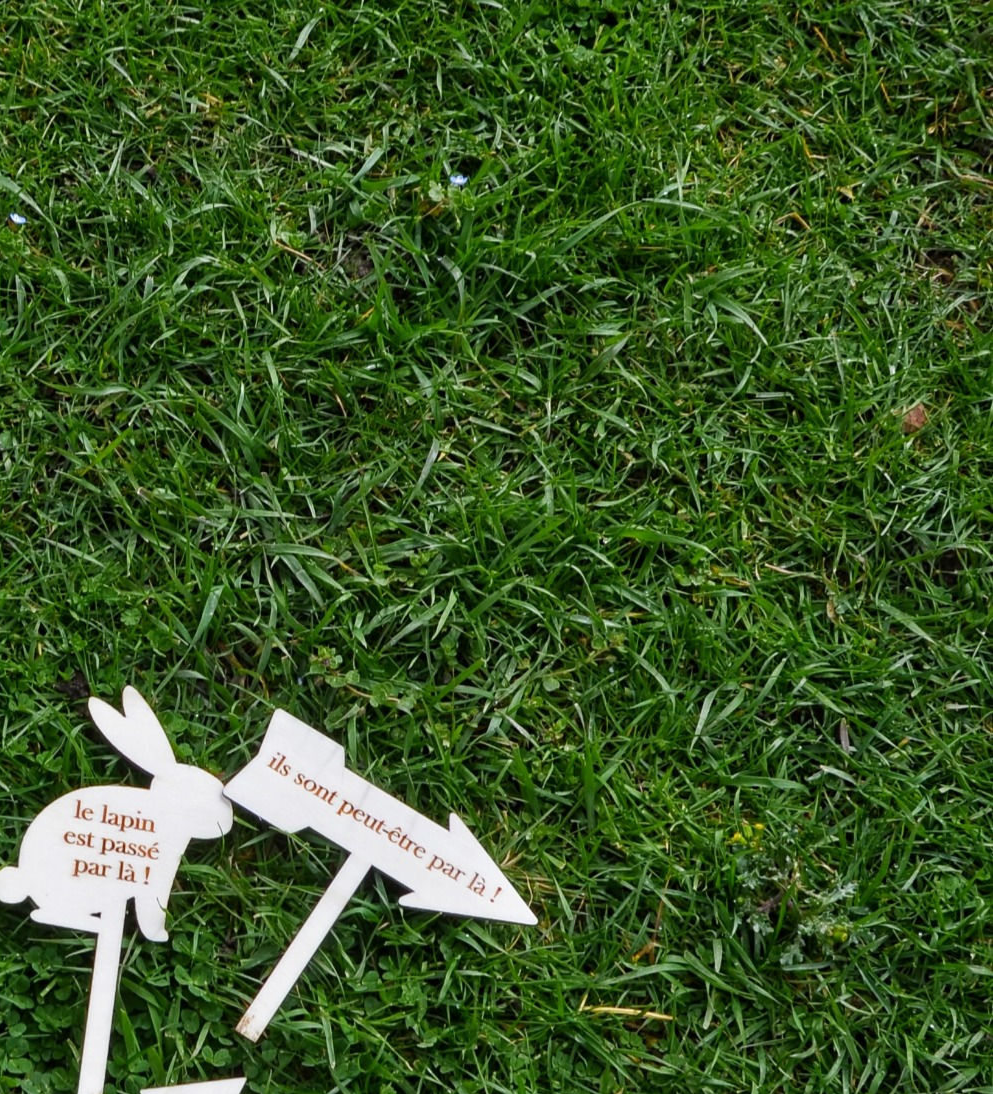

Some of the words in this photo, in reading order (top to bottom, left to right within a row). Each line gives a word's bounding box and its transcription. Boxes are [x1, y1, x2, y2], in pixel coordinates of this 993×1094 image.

[73, 799, 95, 821] le
[100, 804, 156, 833] lapin
[267, 752, 290, 777] ils
[293, 772, 339, 807] sont
[336, 799, 426, 860] peut-être
[426, 854, 466, 884] par
[466, 872, 486, 897] là
[489, 886, 503, 904] !
[63, 830, 95, 848] est
[100, 837, 160, 860] passé
[72, 859, 112, 878] par
[116, 861, 137, 883] là
[143, 866, 151, 885] !
